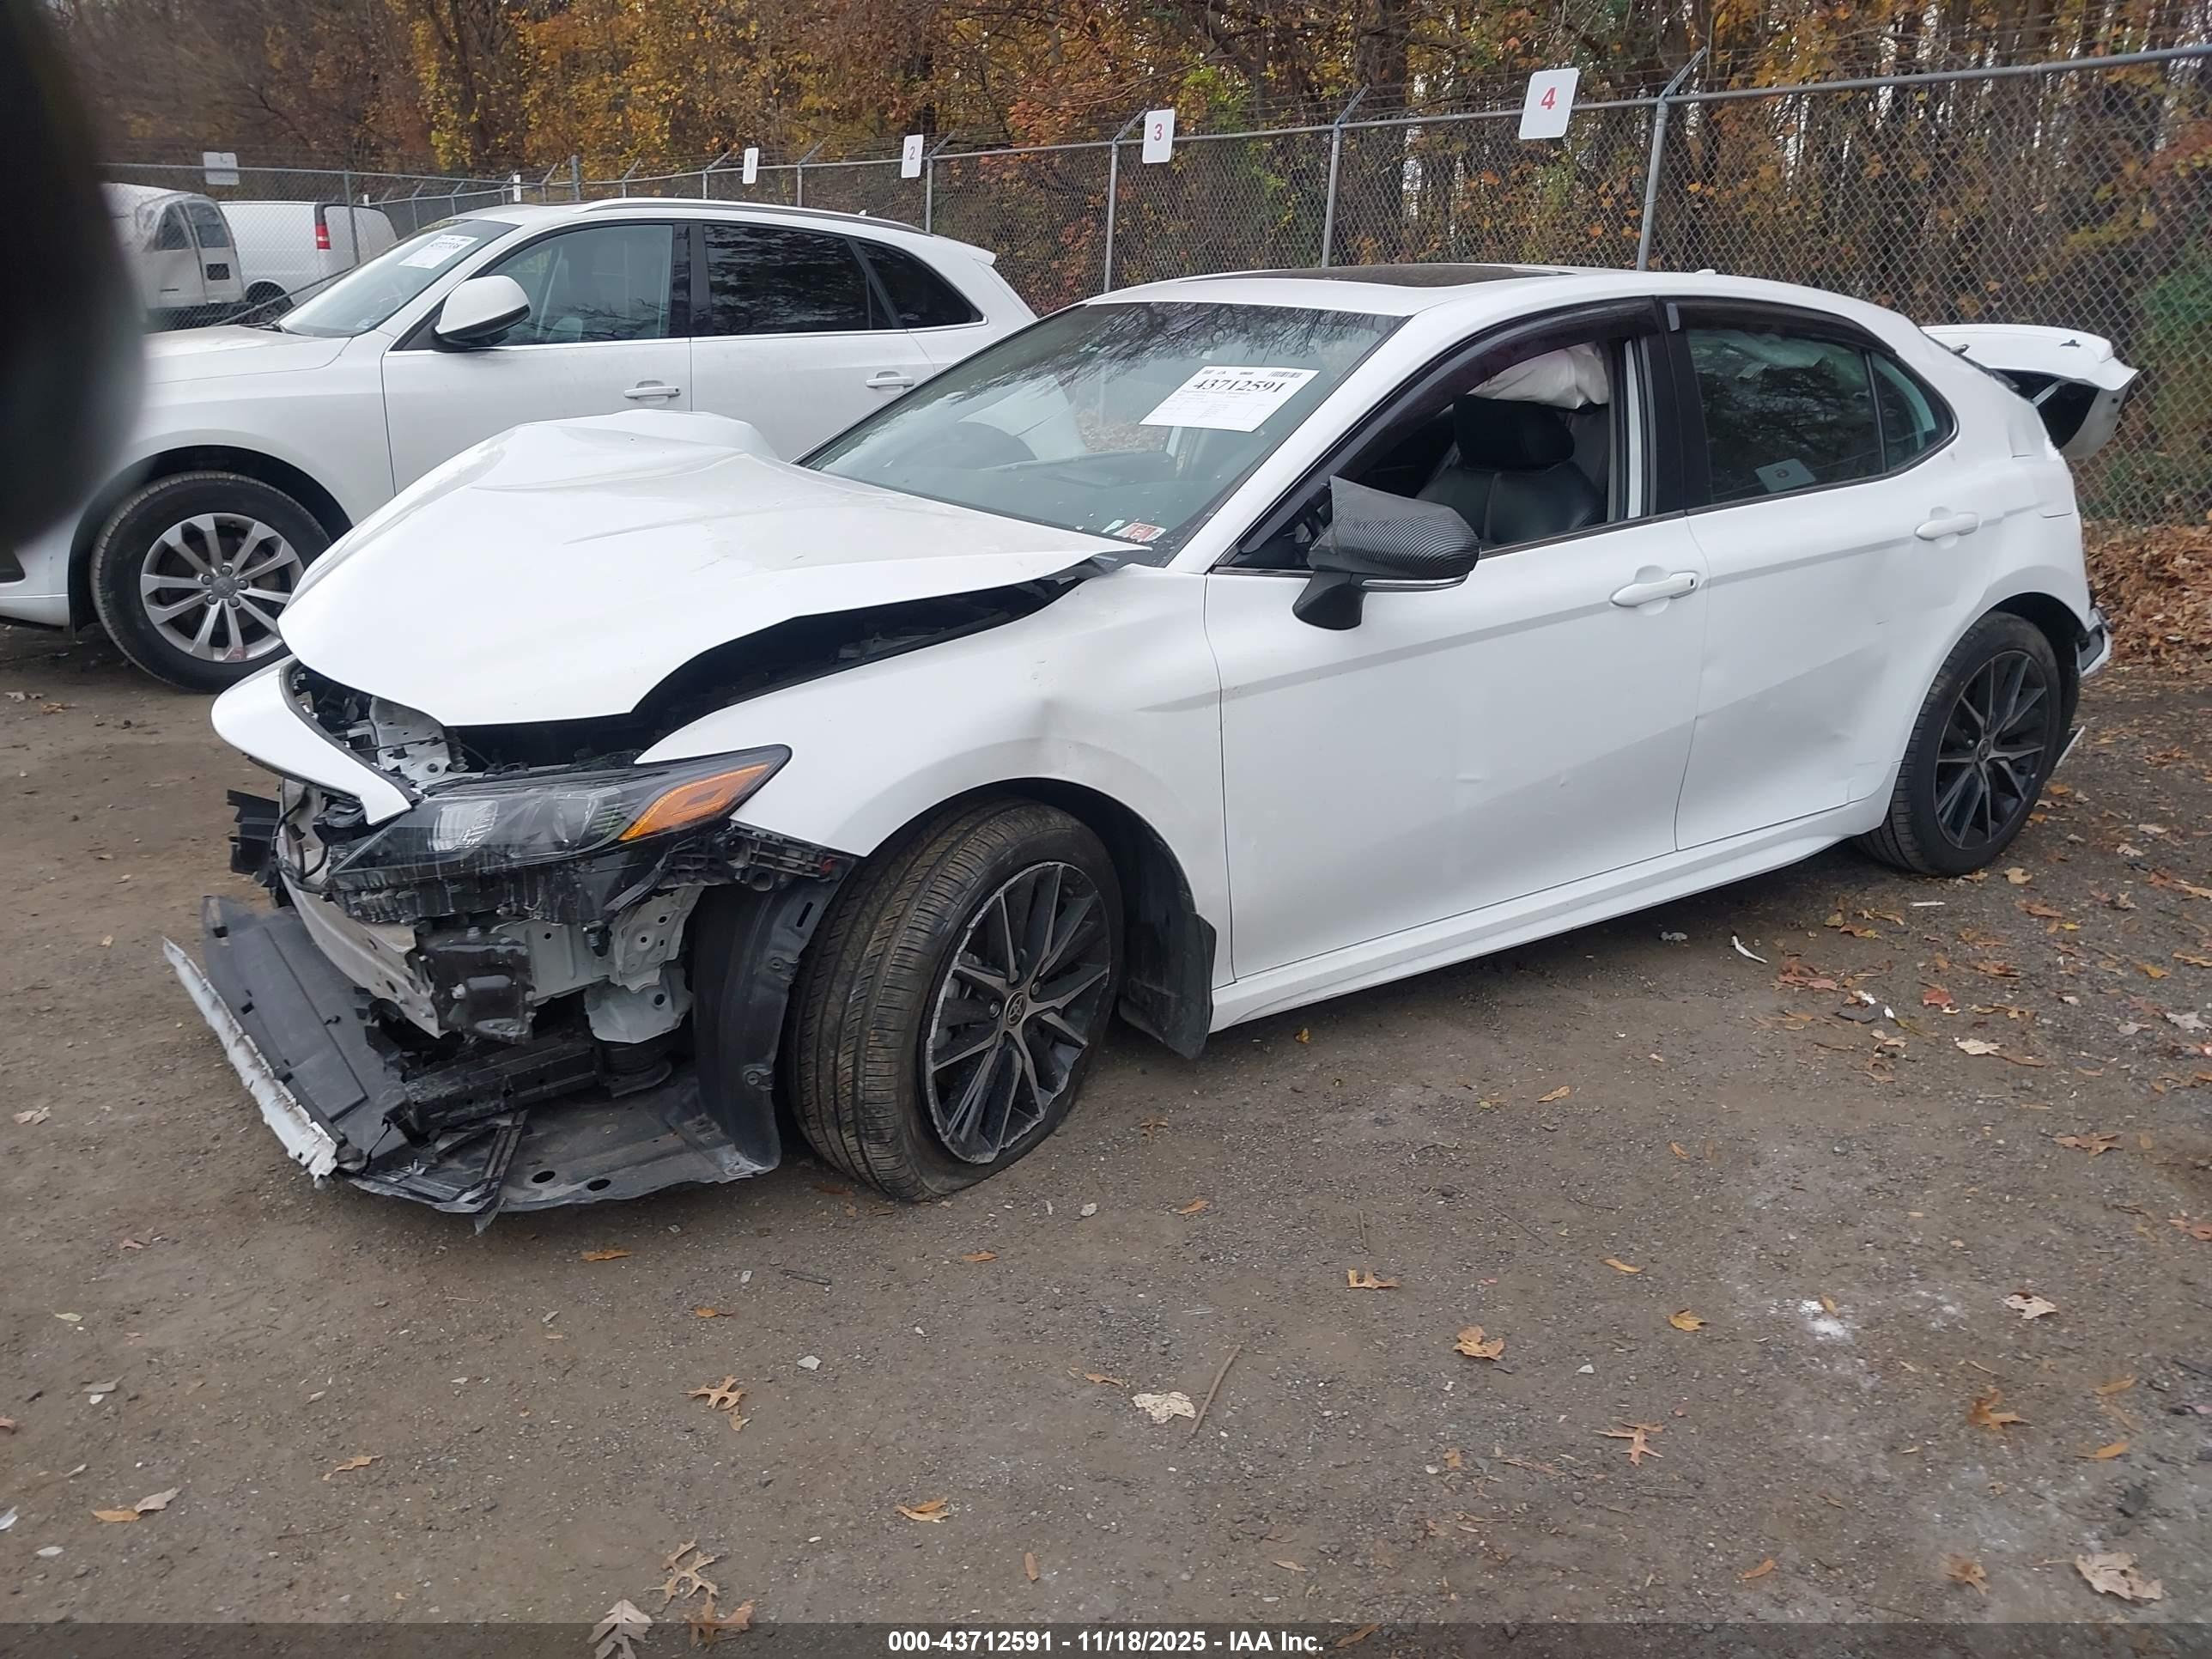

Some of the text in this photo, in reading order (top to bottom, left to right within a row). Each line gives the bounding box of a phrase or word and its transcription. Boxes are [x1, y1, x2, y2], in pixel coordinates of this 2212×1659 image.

[1540, 87, 1556, 110] 4
[1153, 123, 1164, 142] 3
[908, 145, 916, 161] 2
[1193, 379, 1287, 392] 43712591
